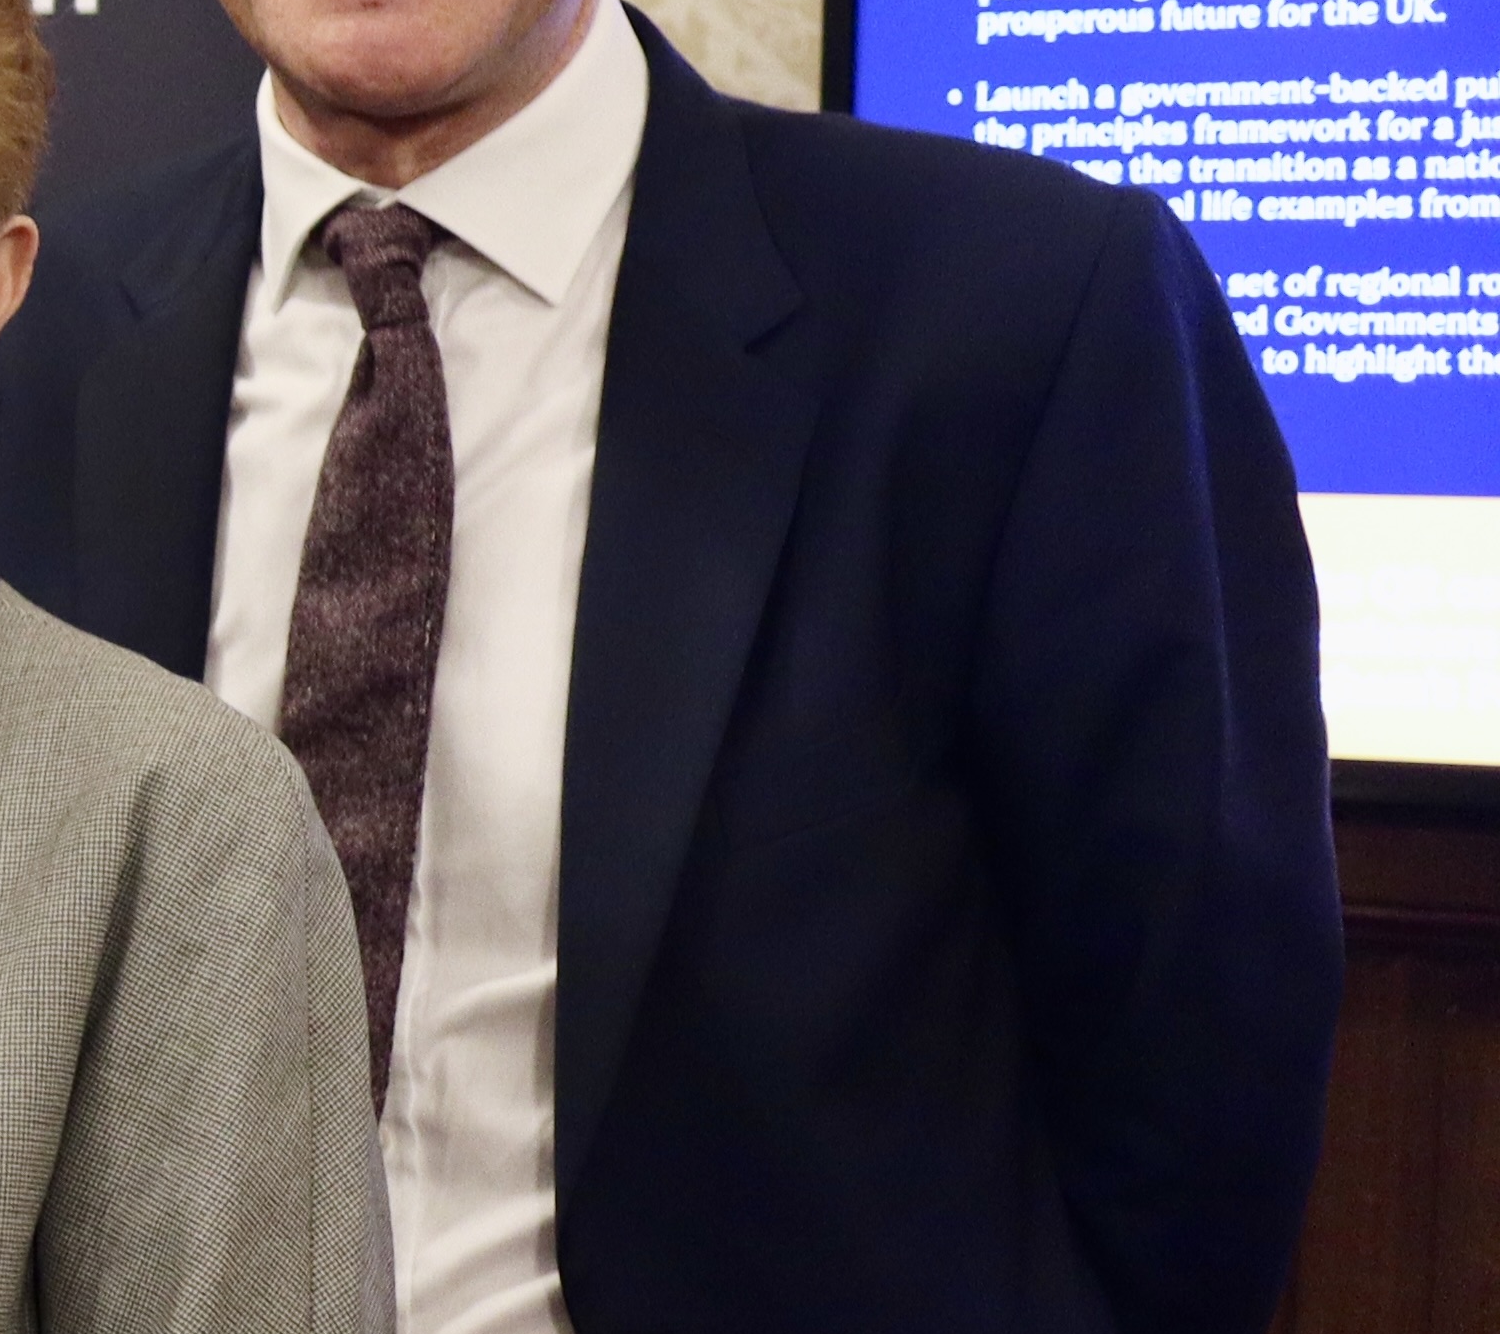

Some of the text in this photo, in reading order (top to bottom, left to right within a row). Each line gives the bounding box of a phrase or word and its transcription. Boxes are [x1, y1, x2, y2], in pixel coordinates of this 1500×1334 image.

[976, 7, 1155, 45] prosperous
[1160, 0, 1261, 31] future
[975, 77, 1089, 112] Launch
[1094, 84, 1115, 109] a
[1119, 69, 1447, 116] government-backed
[973, 116, 1027, 149] the
[1030, 114, 1188, 156] principles
[1192, 110, 1370, 145] framework
[1376, 109, 1429, 141] for
[1432, 116, 1455, 140] a
[1128, 152, 1183, 184] the
[1188, 151, 1347, 183] transition
[1352, 156, 1390, 180] as
[1395, 156, 1417, 180] a
[1201, 188, 1252, 221] life
[1257, 188, 1414, 227] examples
[1419, 186, 1500, 218] from
[1226, 269, 1279, 298] set
[1283, 264, 1323, 298] of
[1325, 265, 1460, 306] regional
[1274, 305, 1499, 337] Governments
[1261, 346, 1299, 375] to
[1303, 342, 1452, 383] highlight
